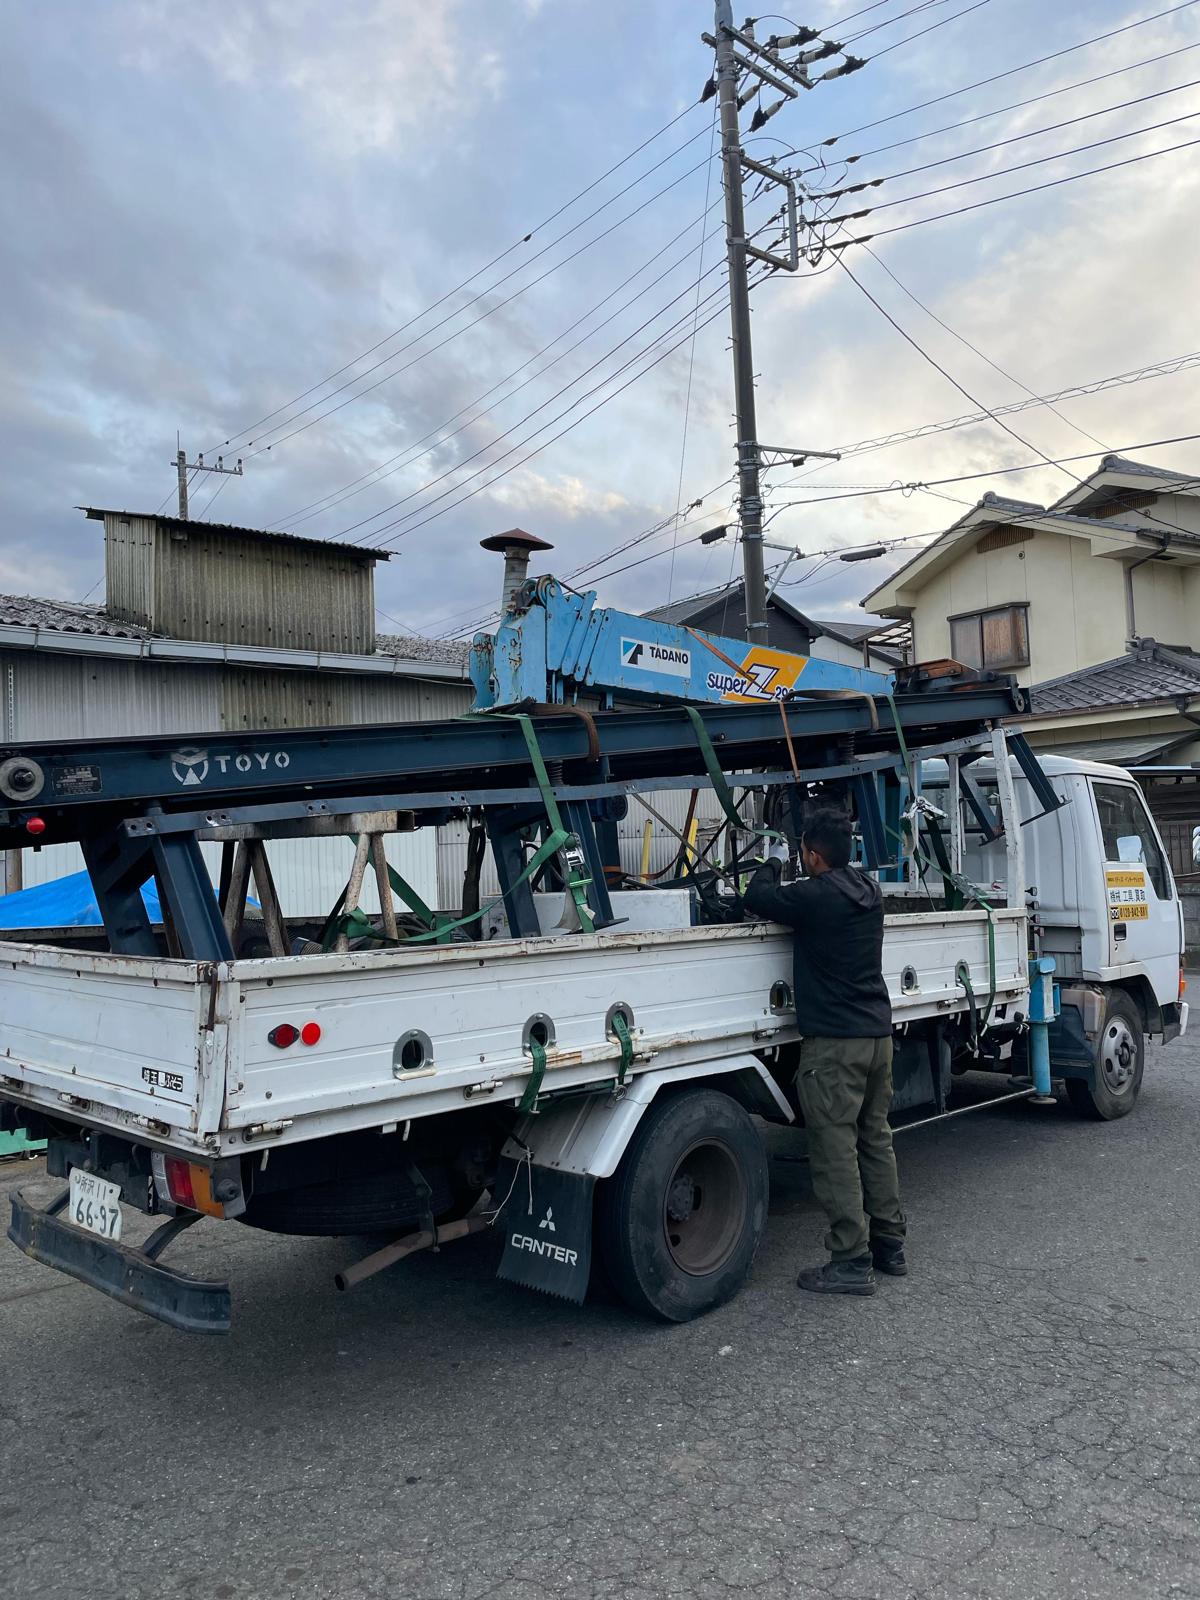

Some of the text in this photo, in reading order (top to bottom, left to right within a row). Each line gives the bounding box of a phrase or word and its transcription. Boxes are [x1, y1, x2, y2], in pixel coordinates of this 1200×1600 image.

[649, 646, 689, 664] TADANO
[707, 673, 747, 695] super
[215, 752, 290, 773] TOYO
[97, 1184, 106, 1200] 11
[511, 1233, 578, 1266] CANTER
